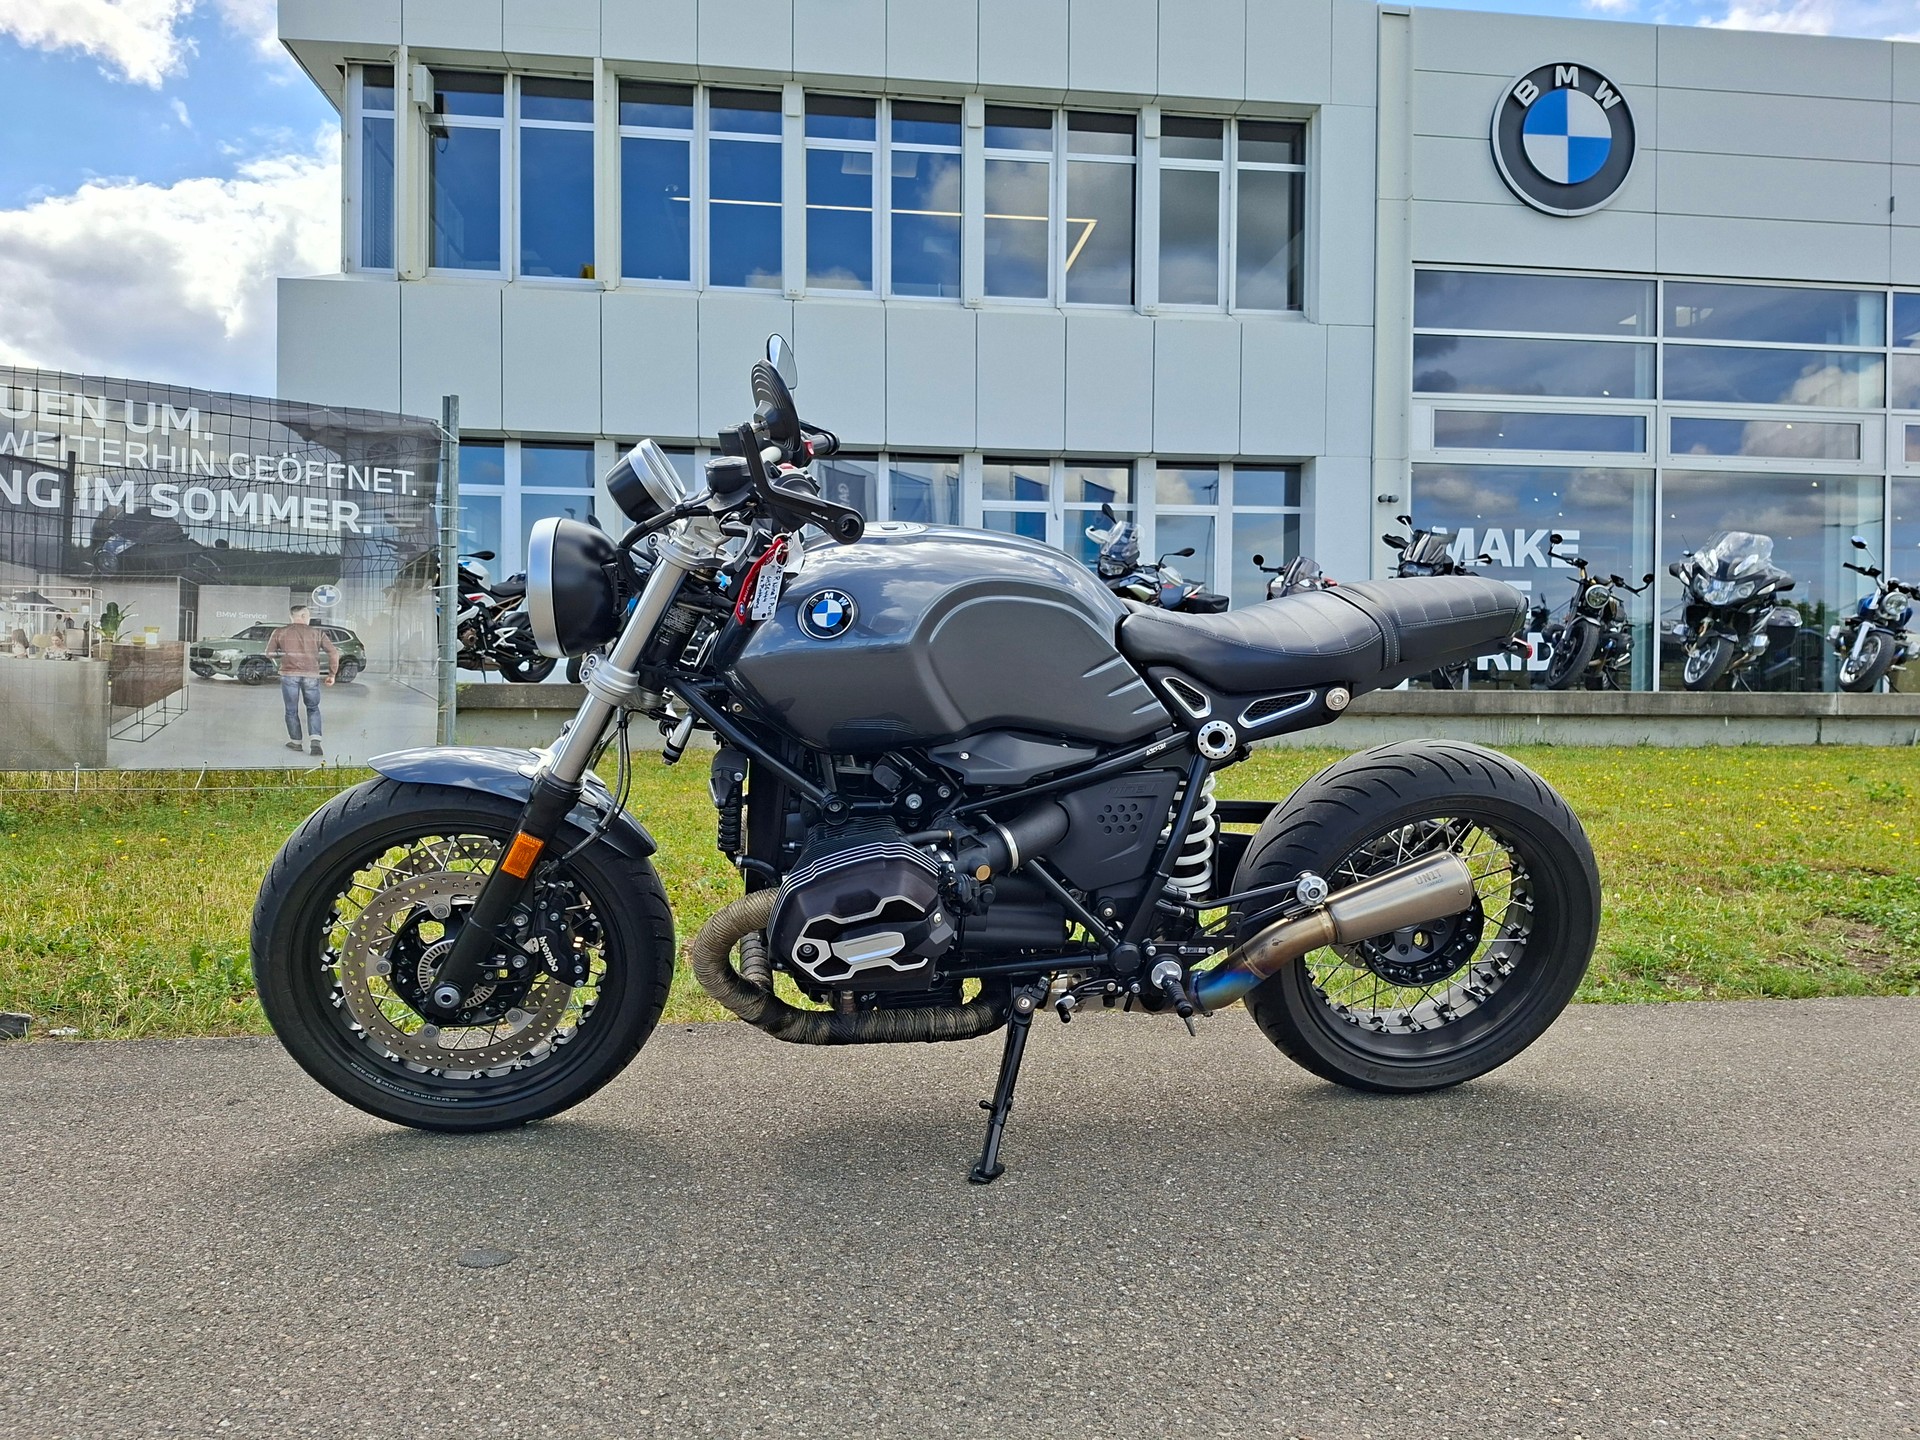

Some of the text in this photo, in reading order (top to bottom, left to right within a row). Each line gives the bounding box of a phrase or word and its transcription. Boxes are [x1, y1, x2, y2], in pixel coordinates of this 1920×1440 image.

[1513, 65, 1621, 110] BMW
[125, 399, 214, 440] UM.
[0, 430, 417, 496] WEITERHIN GEÖFFNET.
[79, 476, 135, 514] IM
[150, 483, 371, 533] SOMMER.
[1432, 526, 1580, 568] MAKE
[216, 610, 267, 619] BMW Service
[1414, 868, 1442, 885] UNIT
[538, 936, 559, 972] brembo
